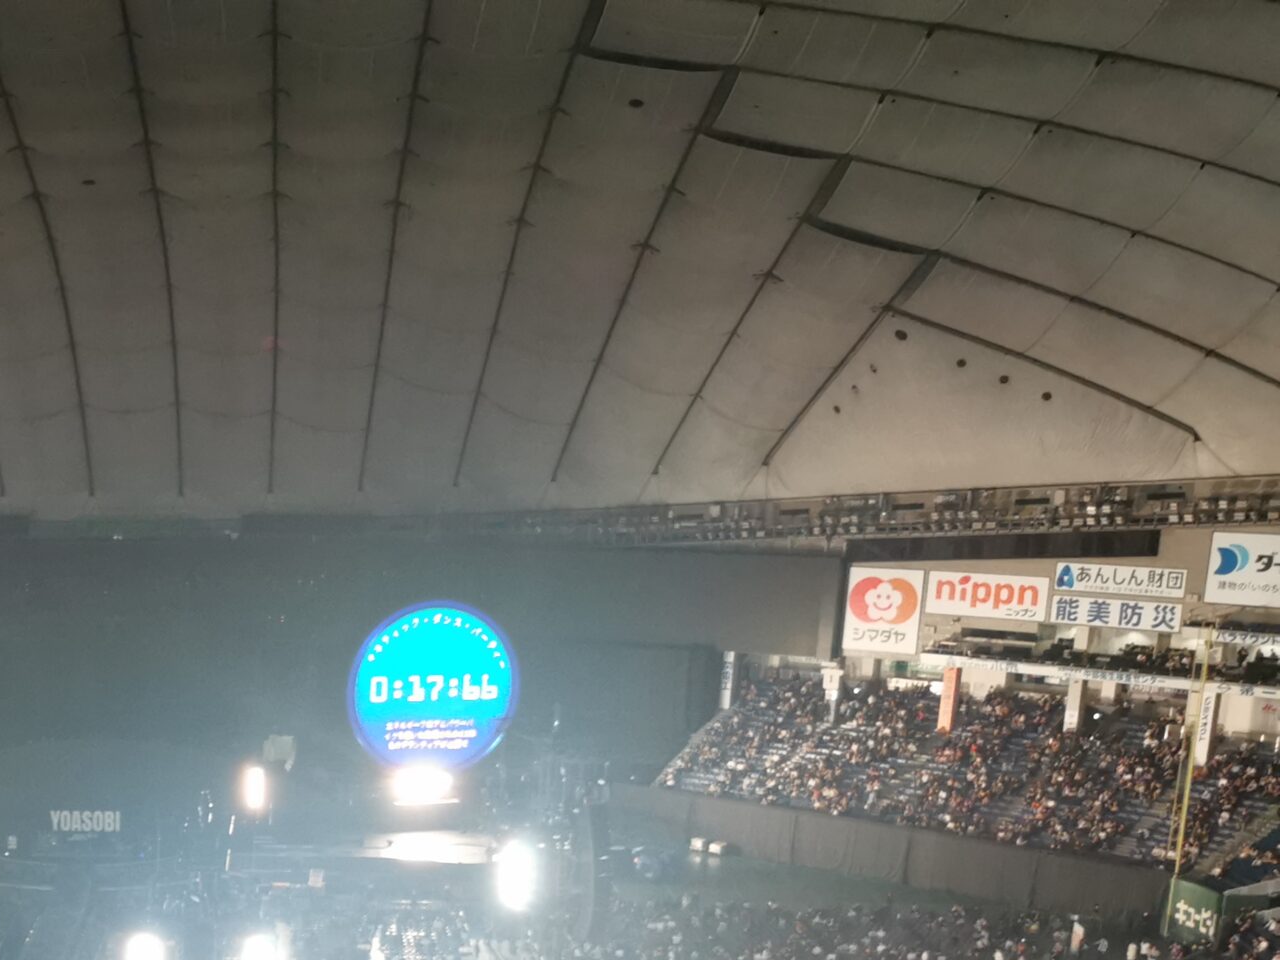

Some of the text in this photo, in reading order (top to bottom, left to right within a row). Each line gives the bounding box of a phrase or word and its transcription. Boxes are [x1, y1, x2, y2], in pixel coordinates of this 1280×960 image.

[1076, 567, 1184, 590] あんしん財団
[935, 575, 1039, 610] nippn
[1005, 608, 1037, 617] ニップン
[1055, 597, 1176, 630] 能美防災
[852, 628, 906, 644] シマダヤ
[50, 811, 120, 832] YOASOBI
